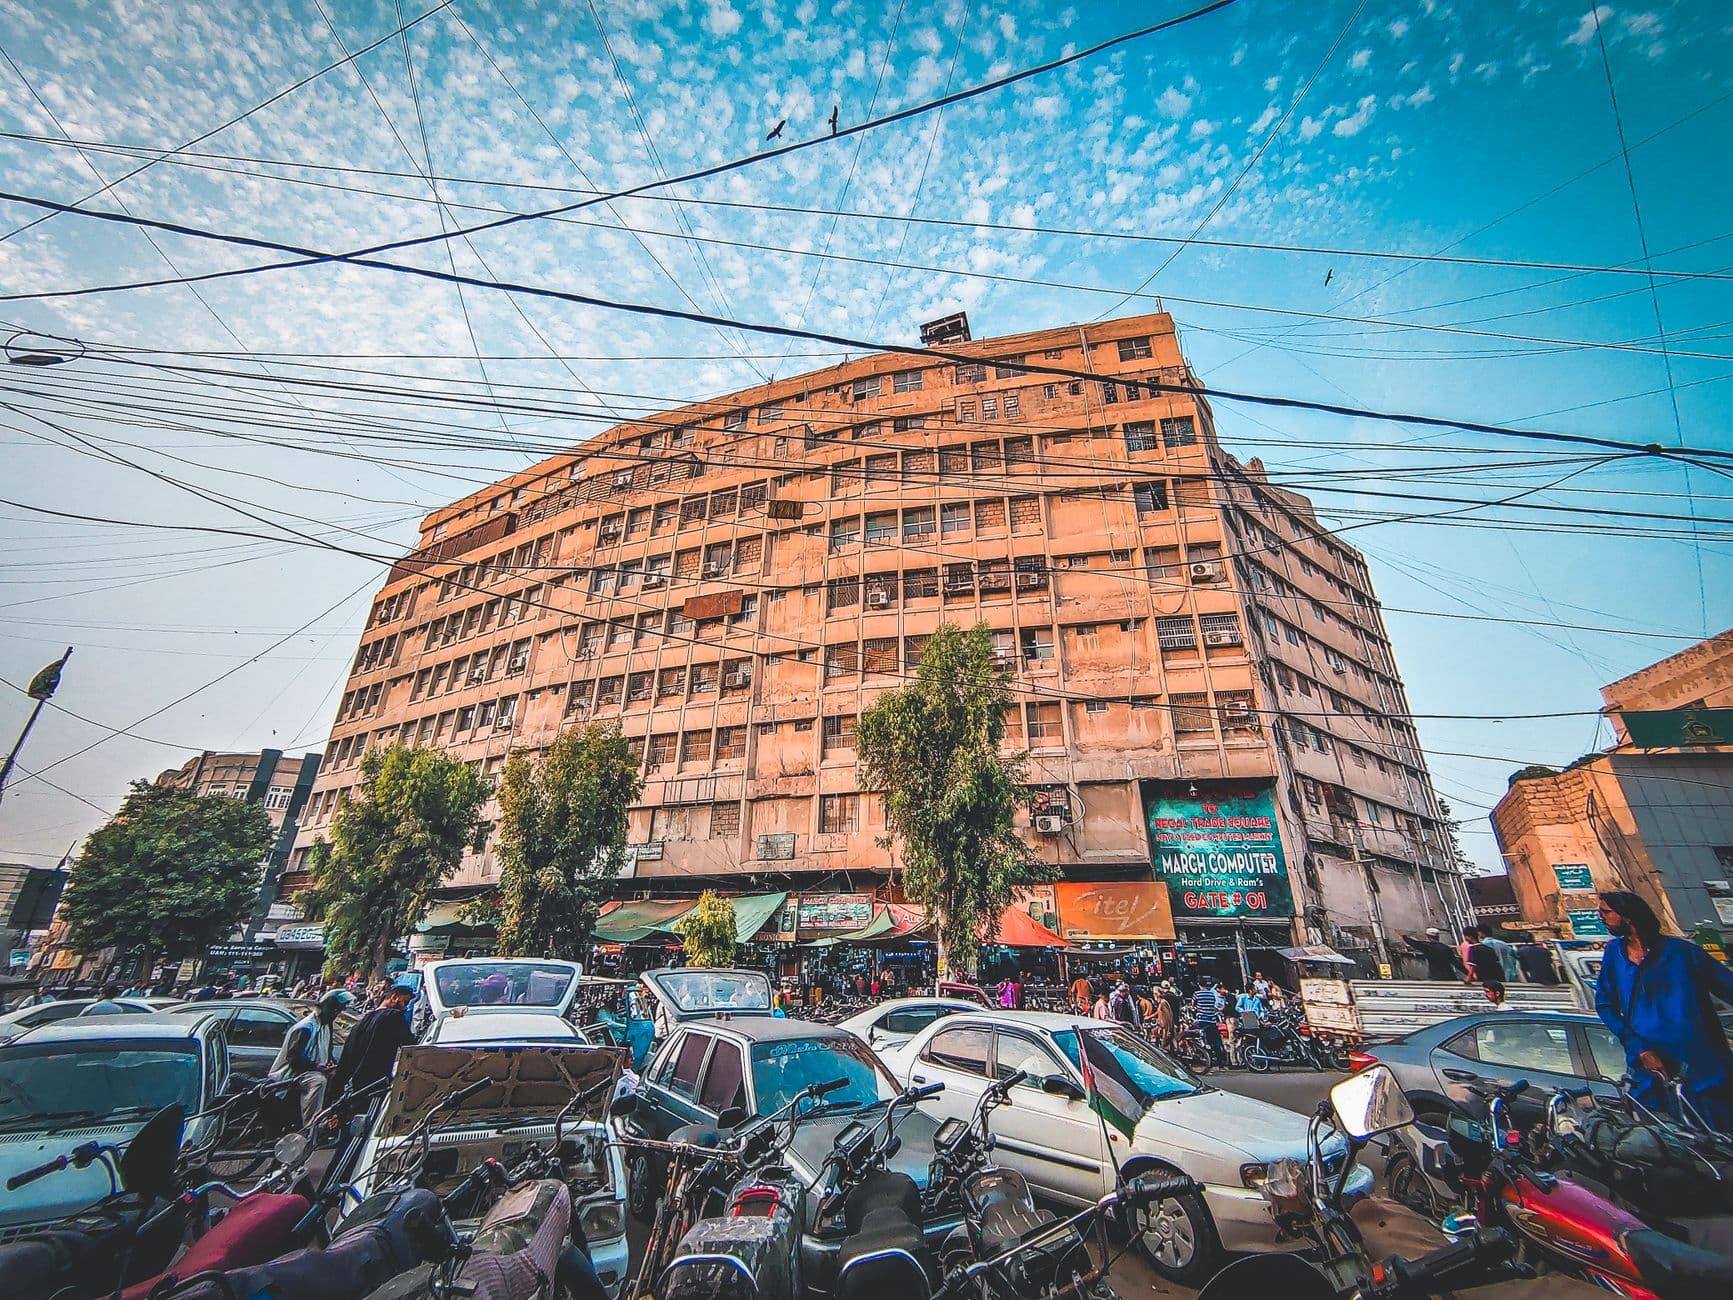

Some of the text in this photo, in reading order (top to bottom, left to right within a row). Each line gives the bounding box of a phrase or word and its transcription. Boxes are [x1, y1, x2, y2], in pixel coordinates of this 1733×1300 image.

[1202, 803, 1218, 814] TO
[1155, 816, 1271, 829] REGAL TRADE SQUARE
[1161, 853, 1278, 874] MARCH COMPUTER
[1181, 877, 1264, 886] Hard Drive & Ram's
[1094, 894, 1139, 915] itel
[1184, 891, 1267, 909] GATE # 01
